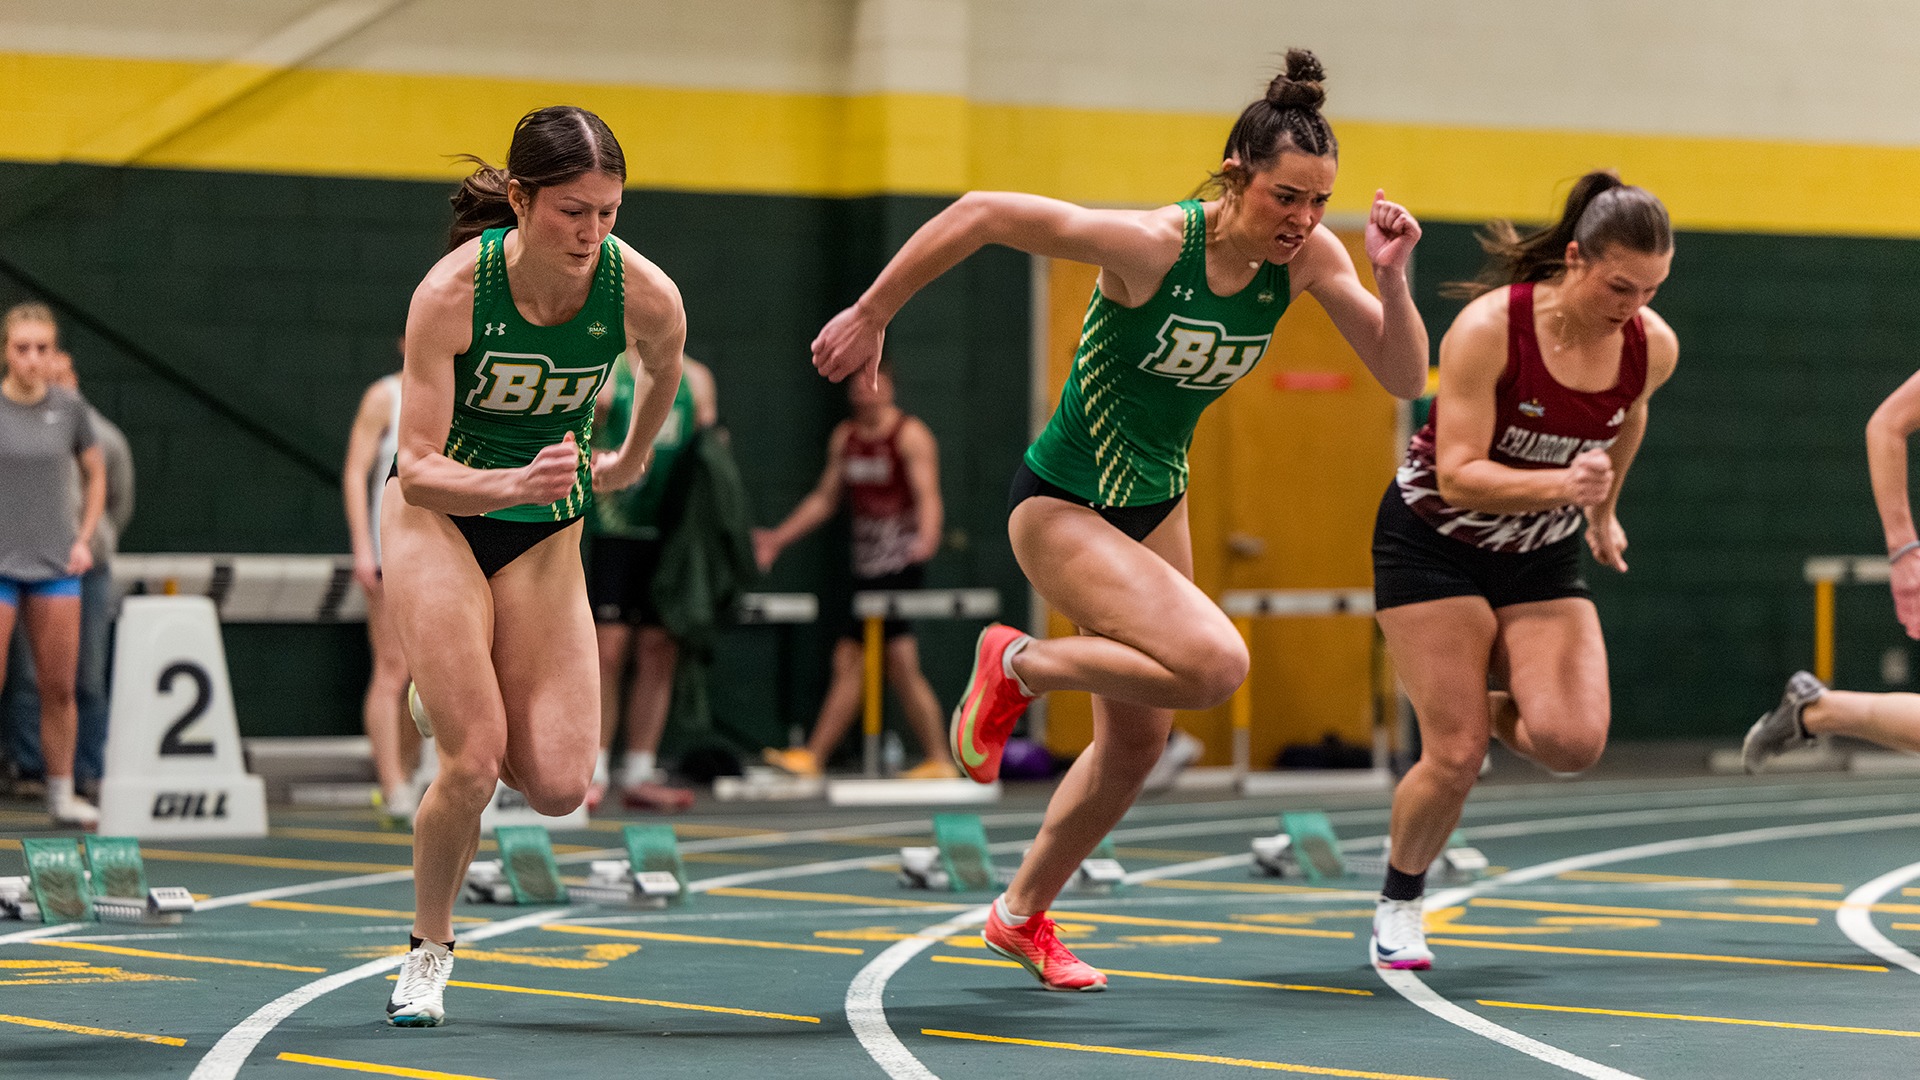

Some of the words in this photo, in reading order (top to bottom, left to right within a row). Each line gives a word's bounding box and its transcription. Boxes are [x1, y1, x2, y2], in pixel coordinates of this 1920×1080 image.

[588, 326, 607, 334] RMAC
[1152, 326, 1263, 385] BH
[478, 362, 599, 416] BH
[157, 660, 216, 757] 2
[152, 791, 229, 819] GILL
